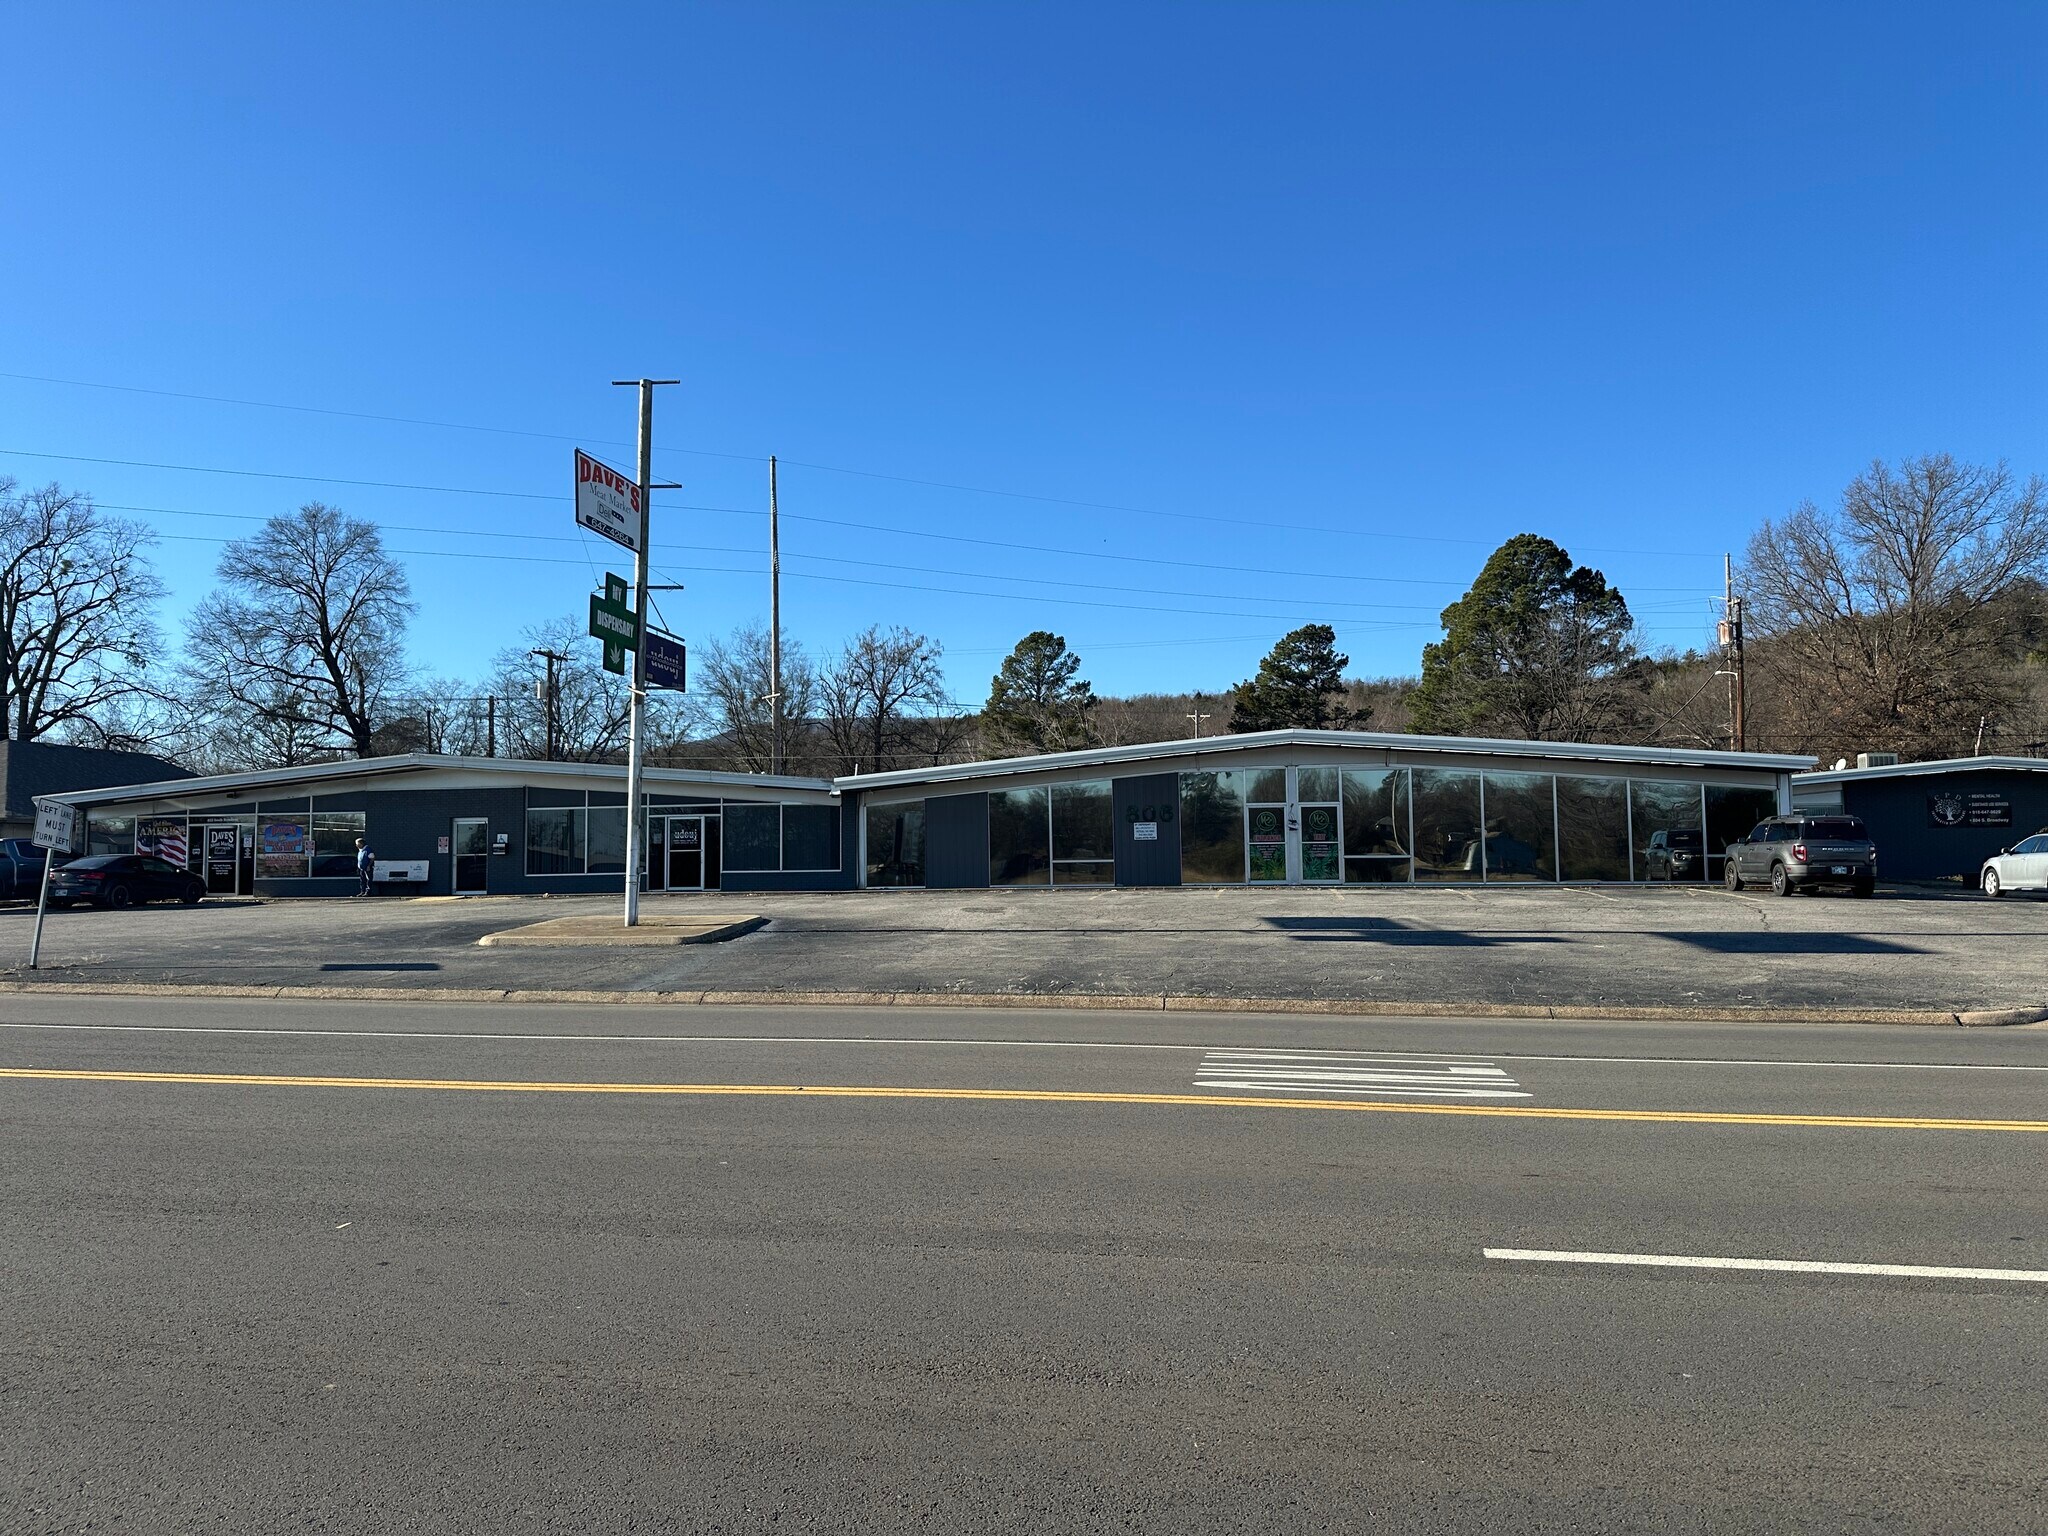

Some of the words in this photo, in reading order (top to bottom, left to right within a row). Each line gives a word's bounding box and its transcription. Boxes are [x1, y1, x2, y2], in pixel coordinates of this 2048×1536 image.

[580, 455, 640, 513] DAVE'S
[588, 482, 607, 502] Meat
[608, 493, 632, 516] Market
[590, 517, 630, 545] 647-4264
[612, 584, 622, 602] MY
[597, 609, 635, 638] DISPENSARY
[40, 804, 58, 815] LEFT
[46, 819, 65, 832] MUST
[139, 825, 187, 836] AMERICA
[36, 831, 53, 842] TURN
[55, 836, 69, 846] LEFT
